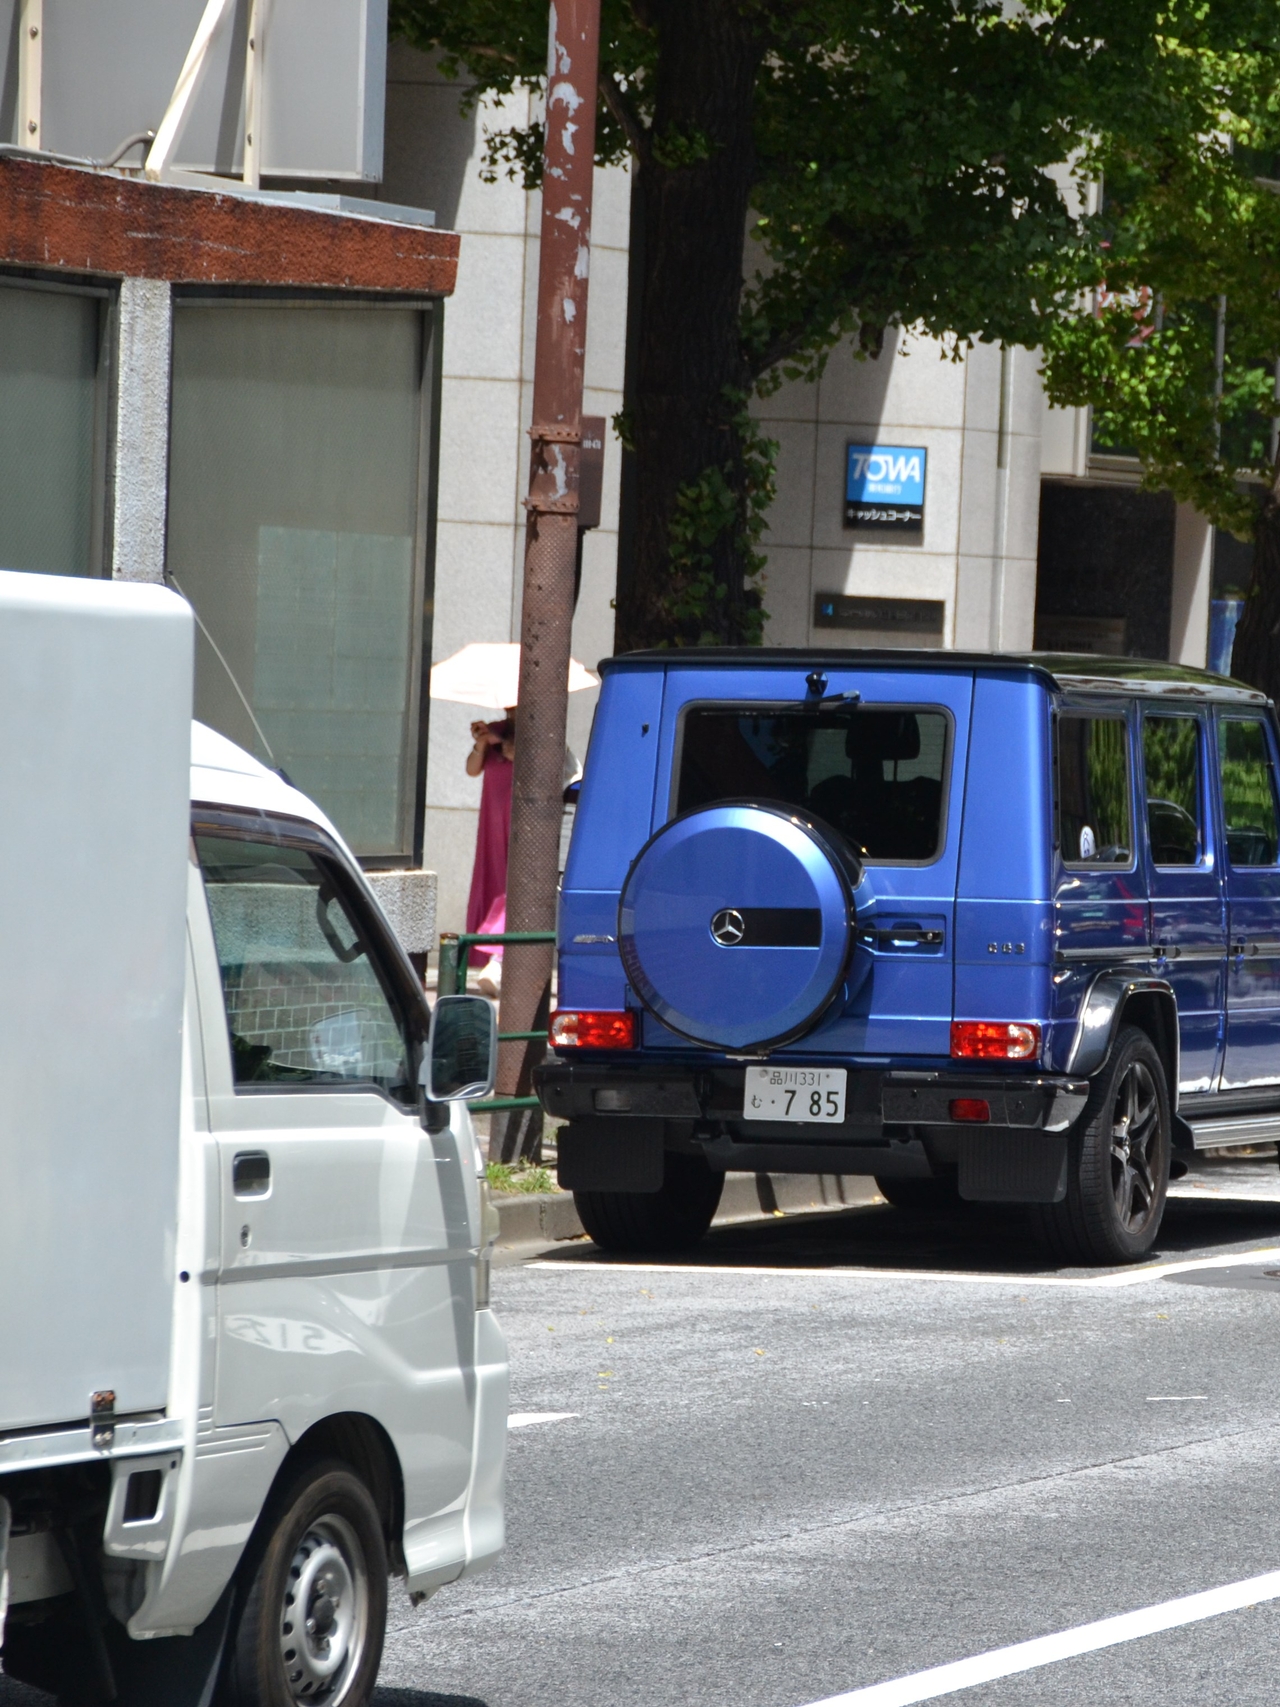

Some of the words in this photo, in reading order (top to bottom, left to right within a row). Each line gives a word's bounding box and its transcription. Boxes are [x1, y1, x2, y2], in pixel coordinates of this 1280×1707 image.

[852, 453, 921, 483] TOWA
[847, 508, 922, 522] キャッシュコーナー
